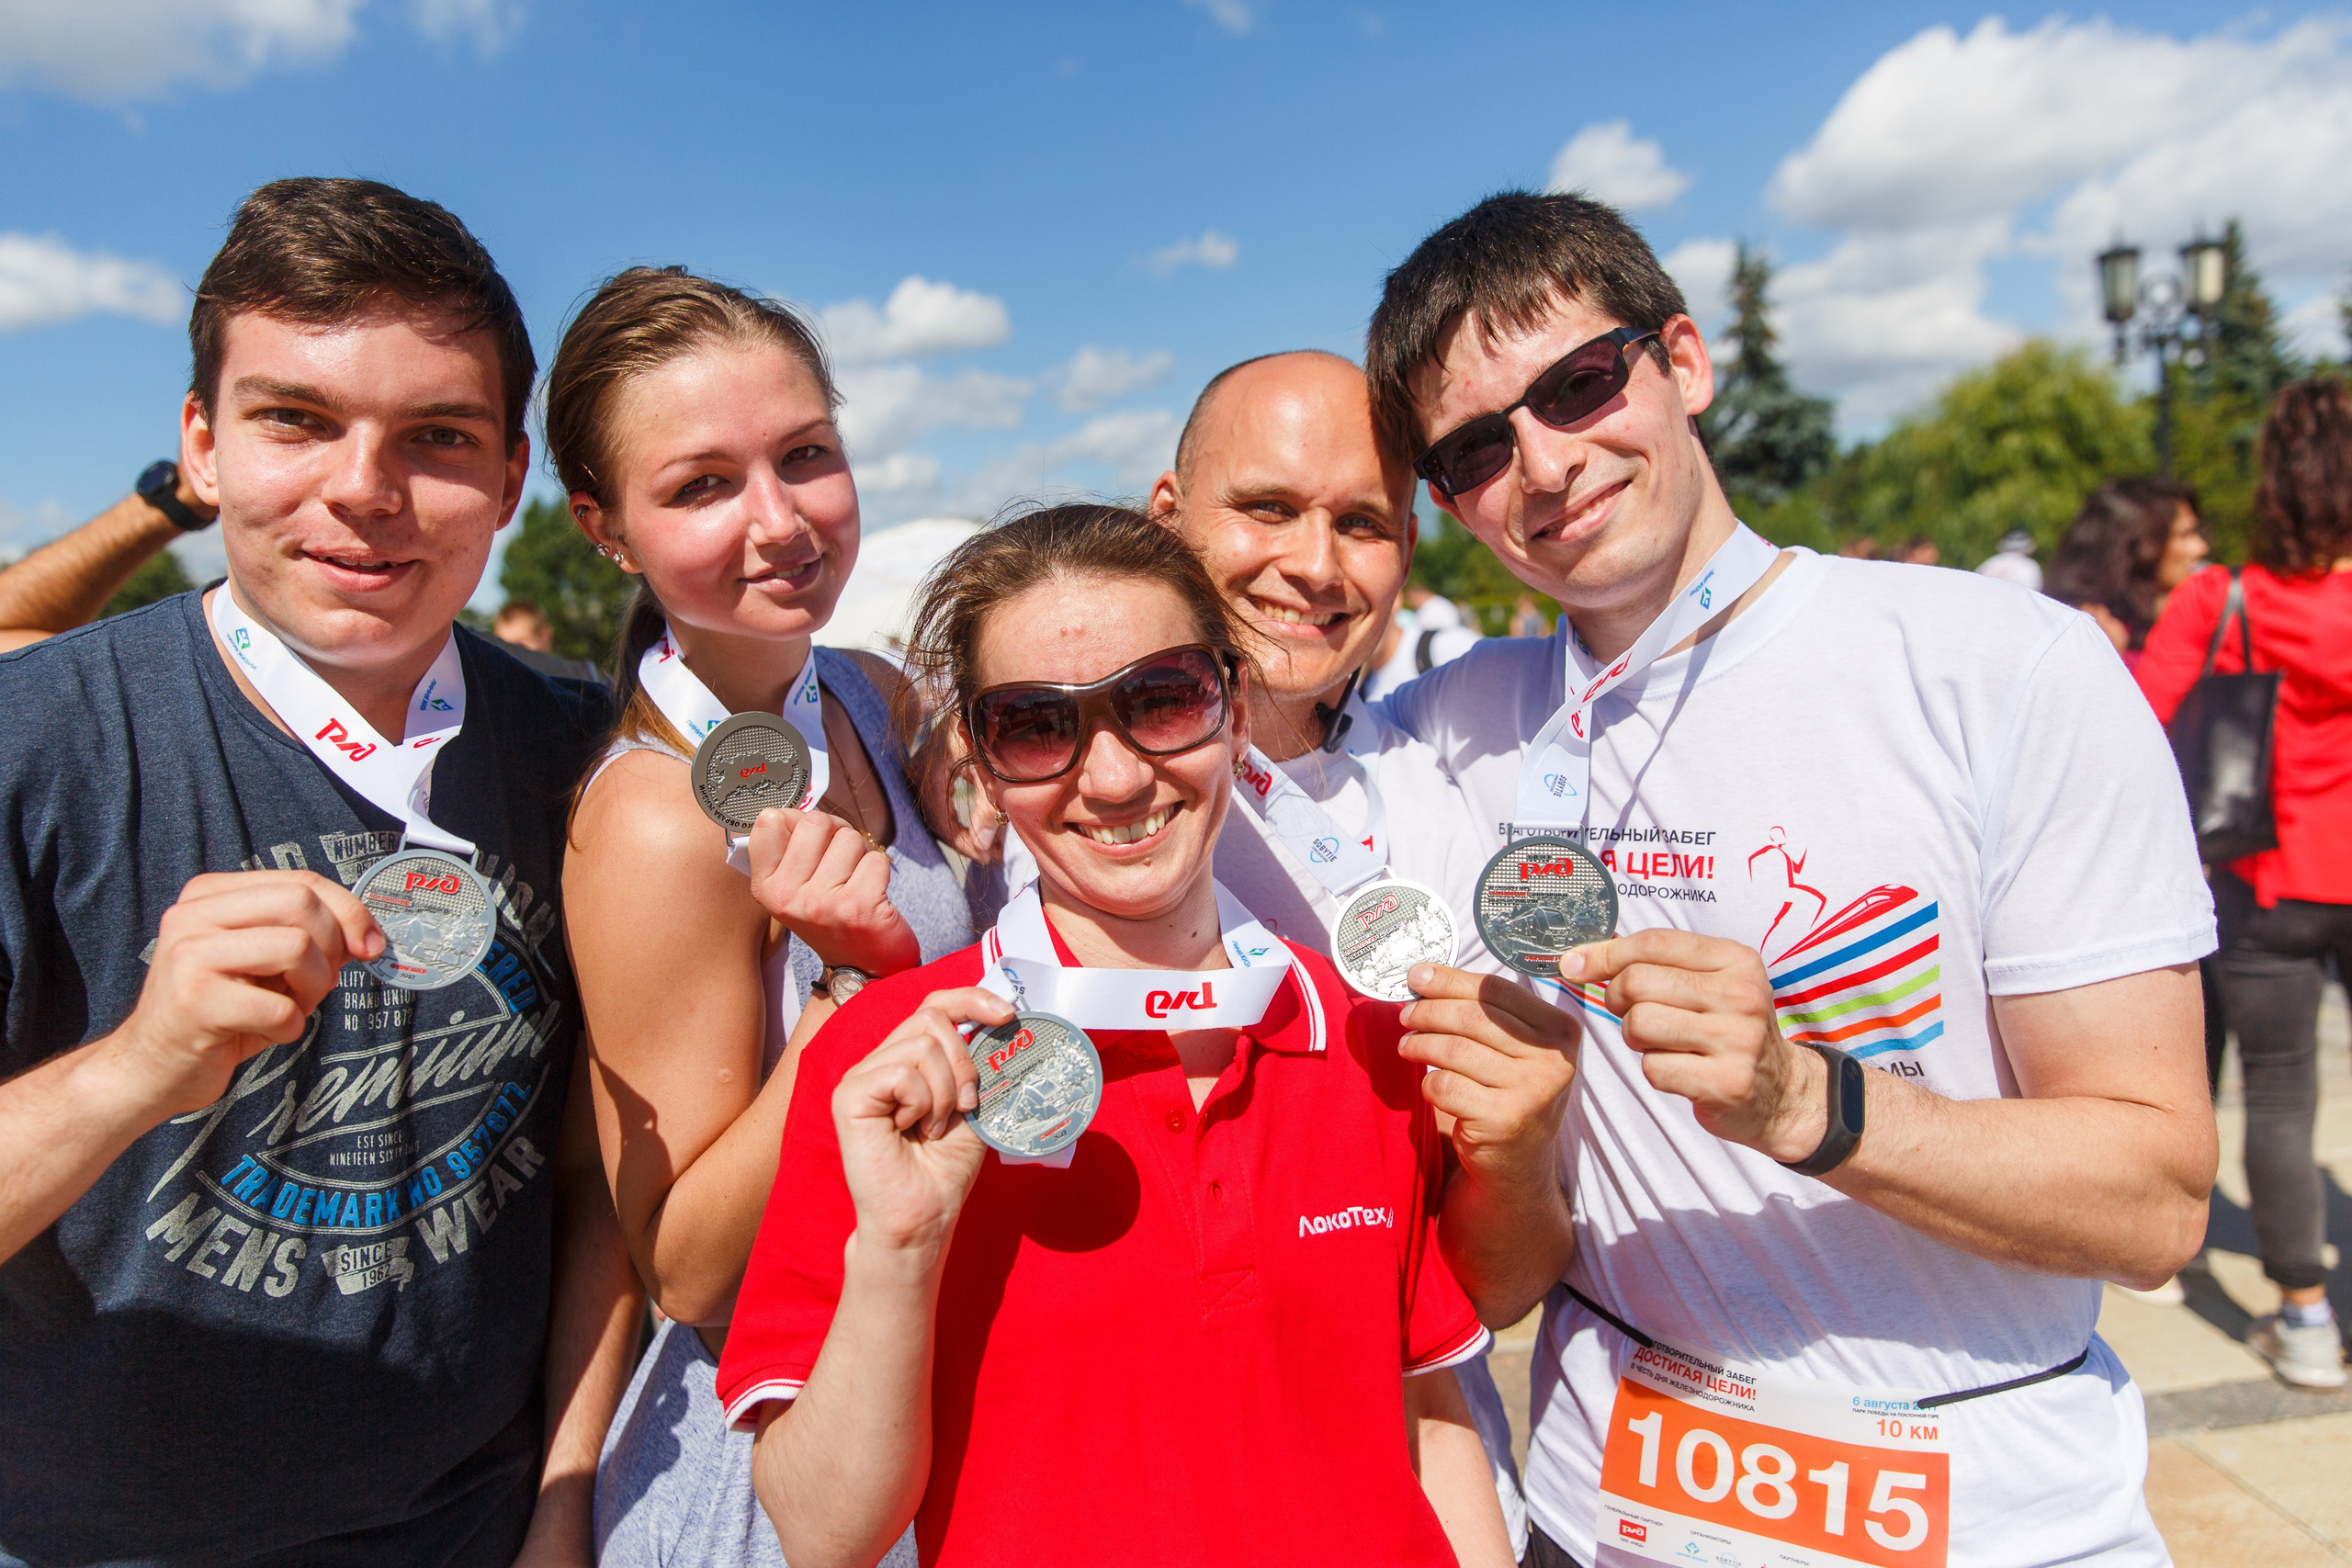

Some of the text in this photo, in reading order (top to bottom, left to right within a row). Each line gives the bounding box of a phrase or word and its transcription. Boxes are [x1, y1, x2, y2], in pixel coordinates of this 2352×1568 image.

[787, 769, 808, 809] ЛОКОМОТИ
[334, 831, 396, 861] NUMBER
[1498, 822, 1716, 845] БАГОТВОРИЕЛЬНЫЙ ЗАБЕГ
[1312, 838, 1338, 863] SOBYTIE
[1627, 852, 1714, 880] ЦЕЛИ!
[1614, 883, 1717, 903] ОДОРОЖНИКА
[336, 971, 365, 987] ALITY
[345, 987, 416, 1010] BRAND UNION
[345, 1014, 359, 1031] NO
[147, 999, 560, 1203] Premium
[357, 1129, 402, 1148] EST SINCE
[220, 1081, 531, 1228] TRADEMARK NO 957872
[329, 1151, 376, 1167] NINETEEN
[145, 1135, 546, 1298] MENS WEAR
[340, 1241, 392, 1273] SINCE
[362, 1264, 391, 1289] 1962
[1633, 1346, 1758, 1401] ДОСТИГАЯ ЦЕЛИ!
[1653, 1341, 1758, 1385] ГОТВОРИТЕЛЬНЫЙ ЗАБЕГ
[1636, 1364, 1655, 1379] ЧЕСТЬ
[1654, 1372, 1668, 1384] ДНЯ
[1668, 1378, 1757, 1413] ЖЕЛЕЗНОДОРОЖНИКА
[1852, 1396, 1860, 1406] 6
[1863, 1398, 1910, 1411] августа
[1877, 1418, 1903, 1438] 10
[1628, 1411, 1928, 1551] 10815
